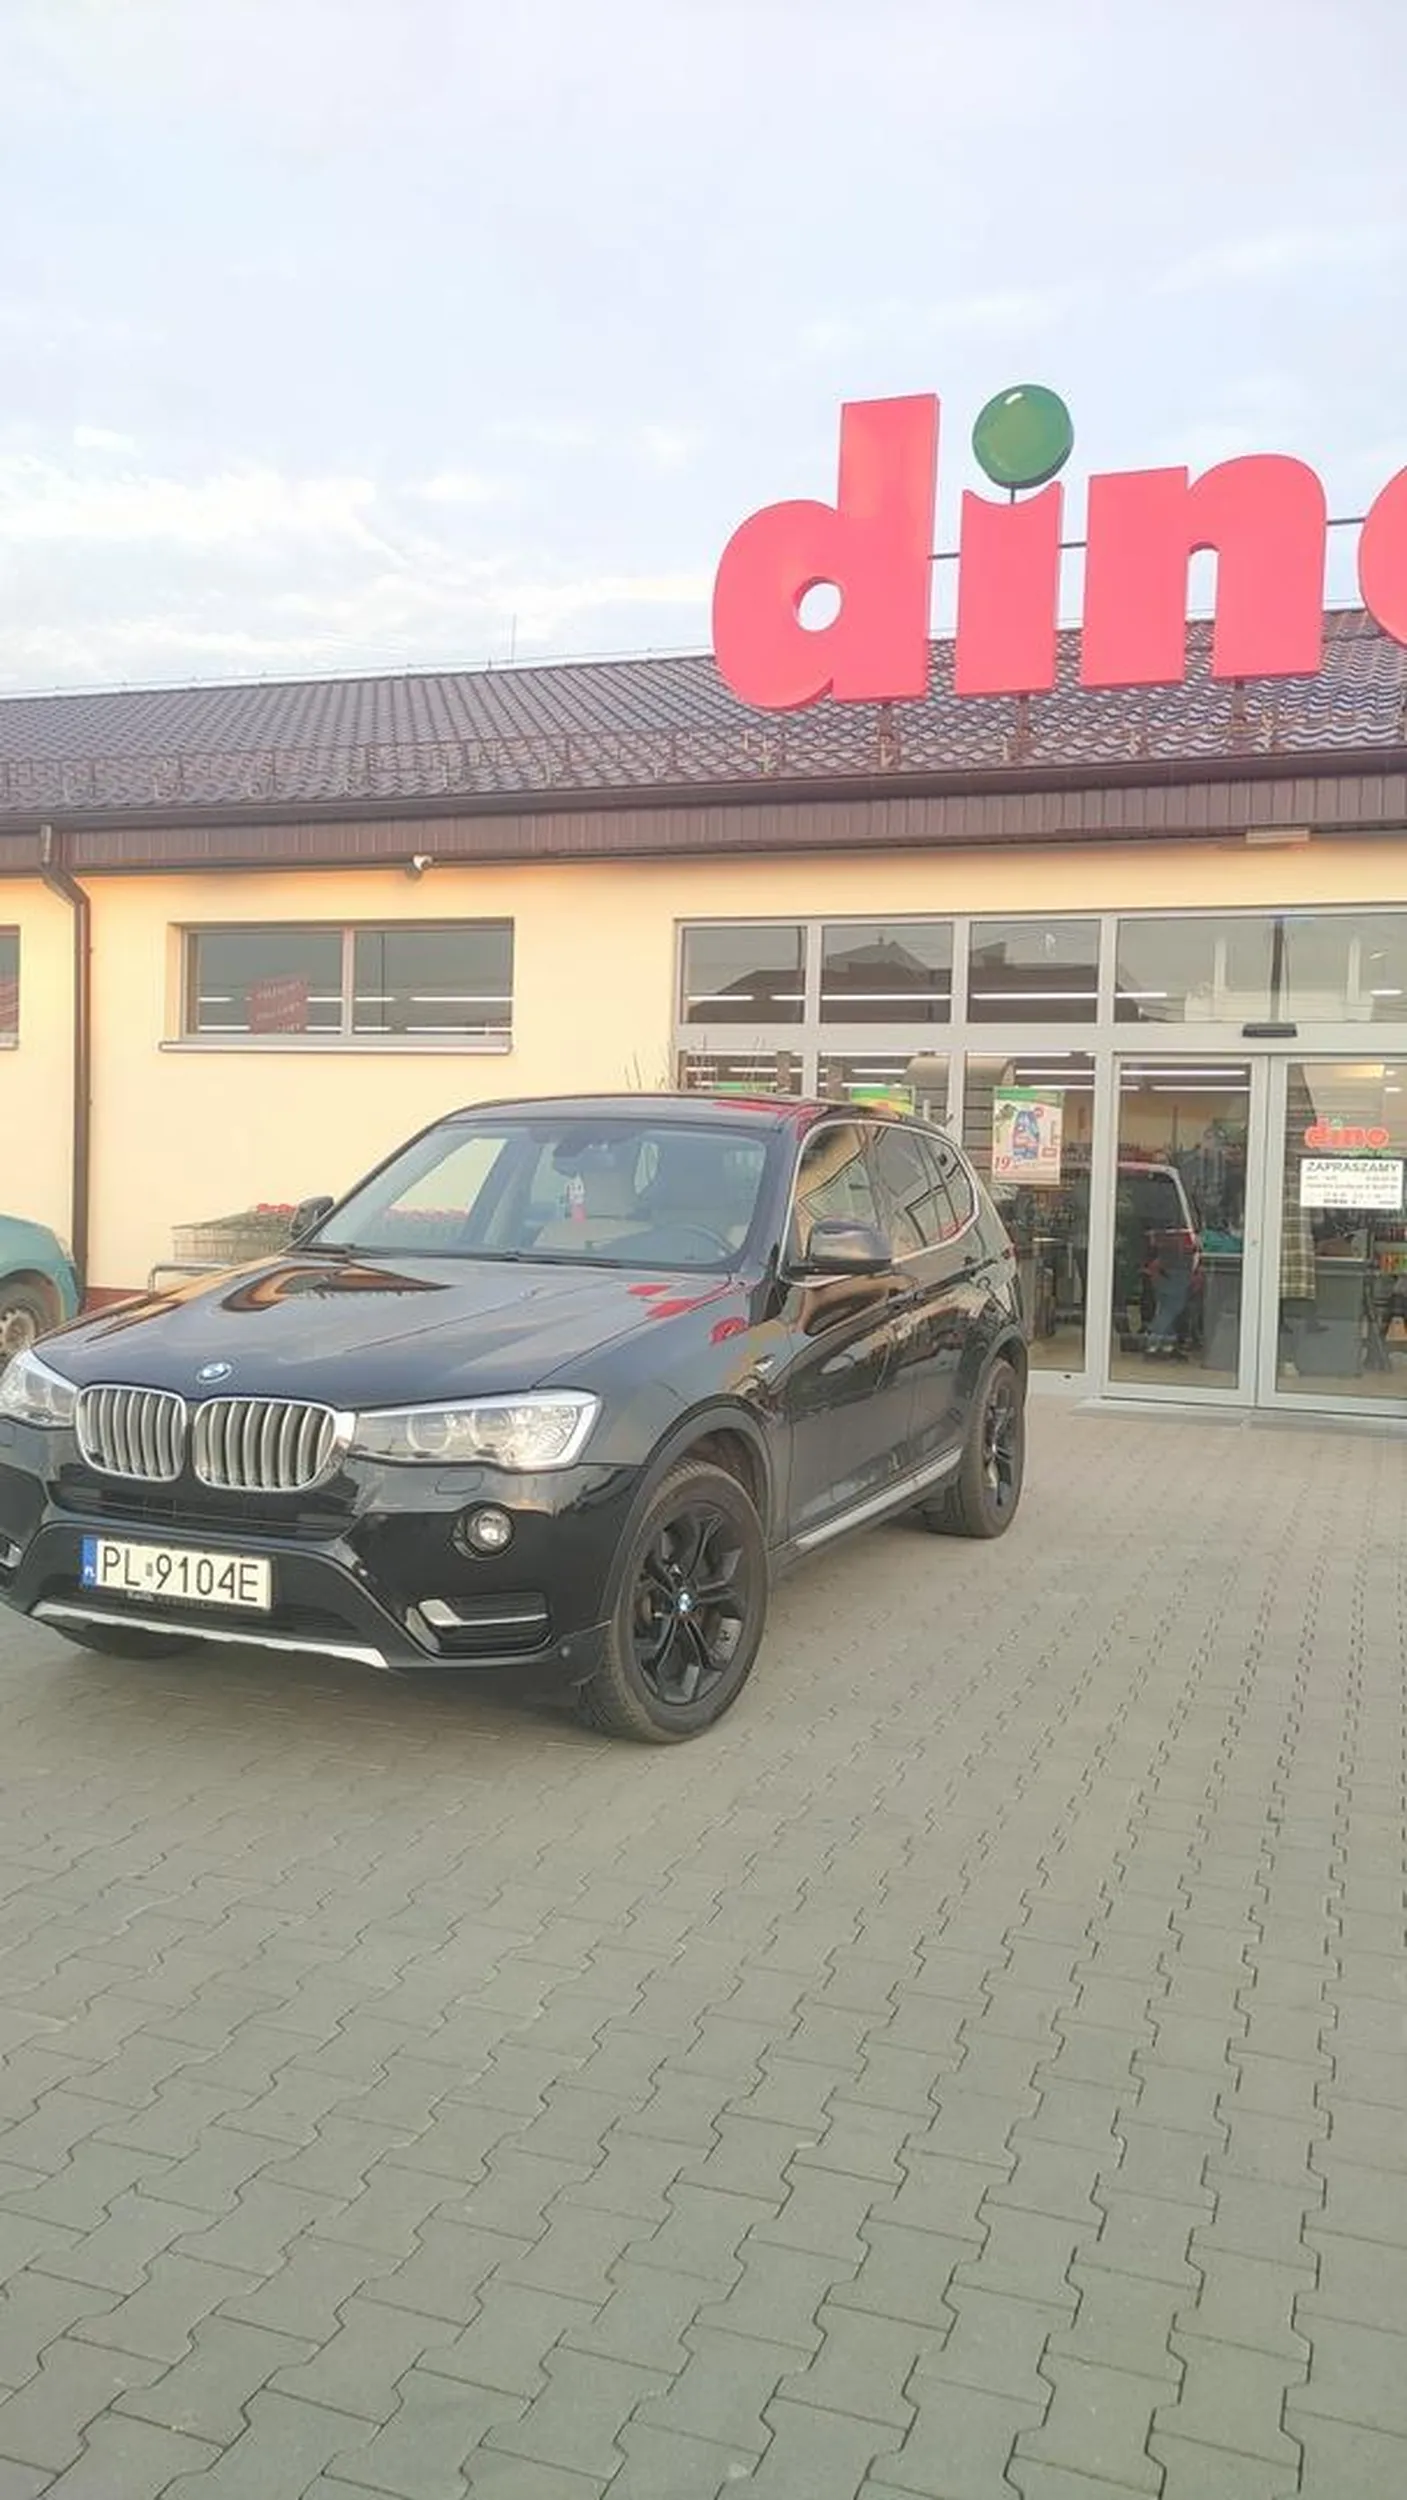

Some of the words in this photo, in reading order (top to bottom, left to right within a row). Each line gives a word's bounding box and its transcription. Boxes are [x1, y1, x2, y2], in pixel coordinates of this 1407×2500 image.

[713, 384, 1407, 710] din
[1304, 1115, 1389, 1149] dino
[1306, 1161, 1399, 1172] ZAPRASZAMY
[102, 1546, 141, 1587] PL
[156, 1553, 258, 1602] 9104E
